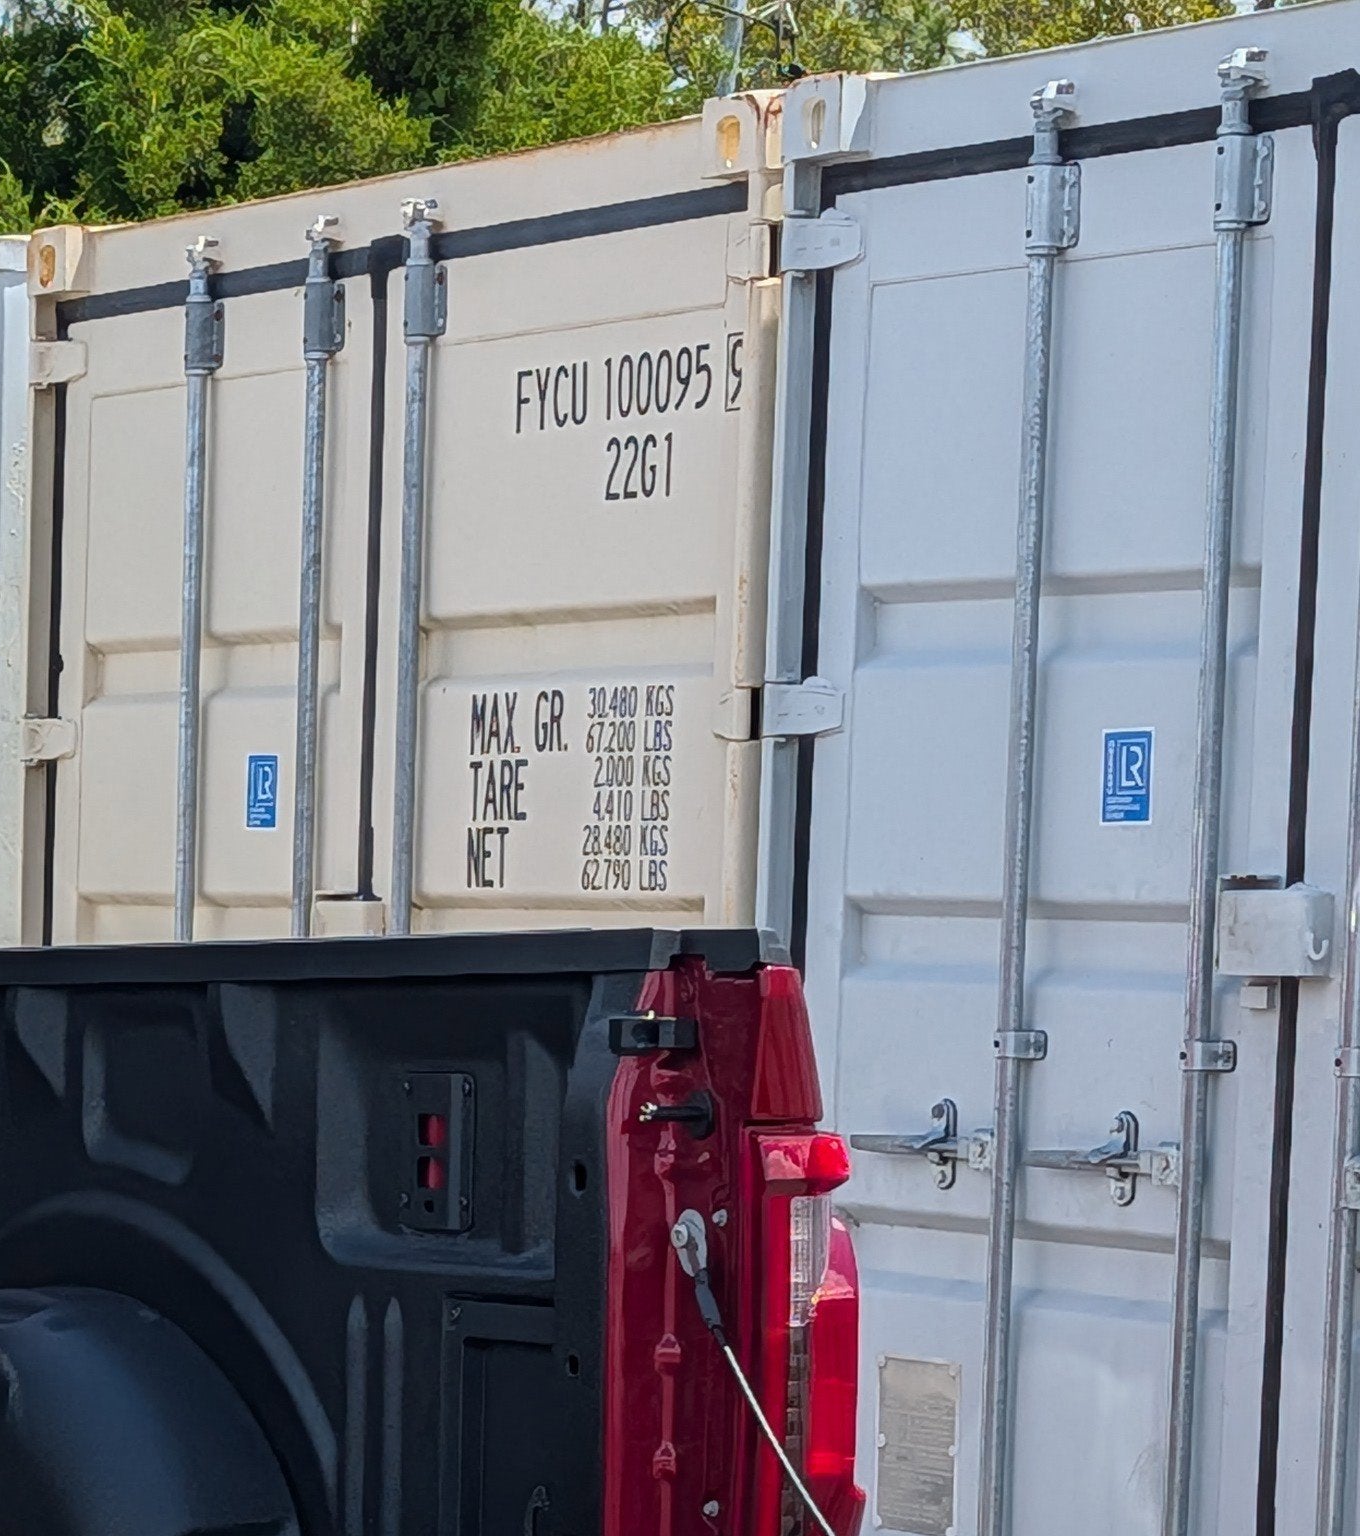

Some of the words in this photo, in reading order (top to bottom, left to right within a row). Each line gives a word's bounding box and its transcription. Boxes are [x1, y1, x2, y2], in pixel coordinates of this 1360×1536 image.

[515, 360, 588, 434] FYCU
[604, 343, 712, 421] 100095
[605, 432, 673, 501] 22G1
[645, 685, 675, 717] KGS
[469, 691, 521, 756] MAX.
[534, 689, 569, 752] GR.
[643, 720, 673, 752] LBS
[641, 755, 672, 788] KGS
[469, 758, 528, 822] TARE
[640, 790, 670, 822] LBS
[467, 826, 509, 888] NET
[639, 824, 669, 857] KGS
[639, 859, 668, 892] LBS
